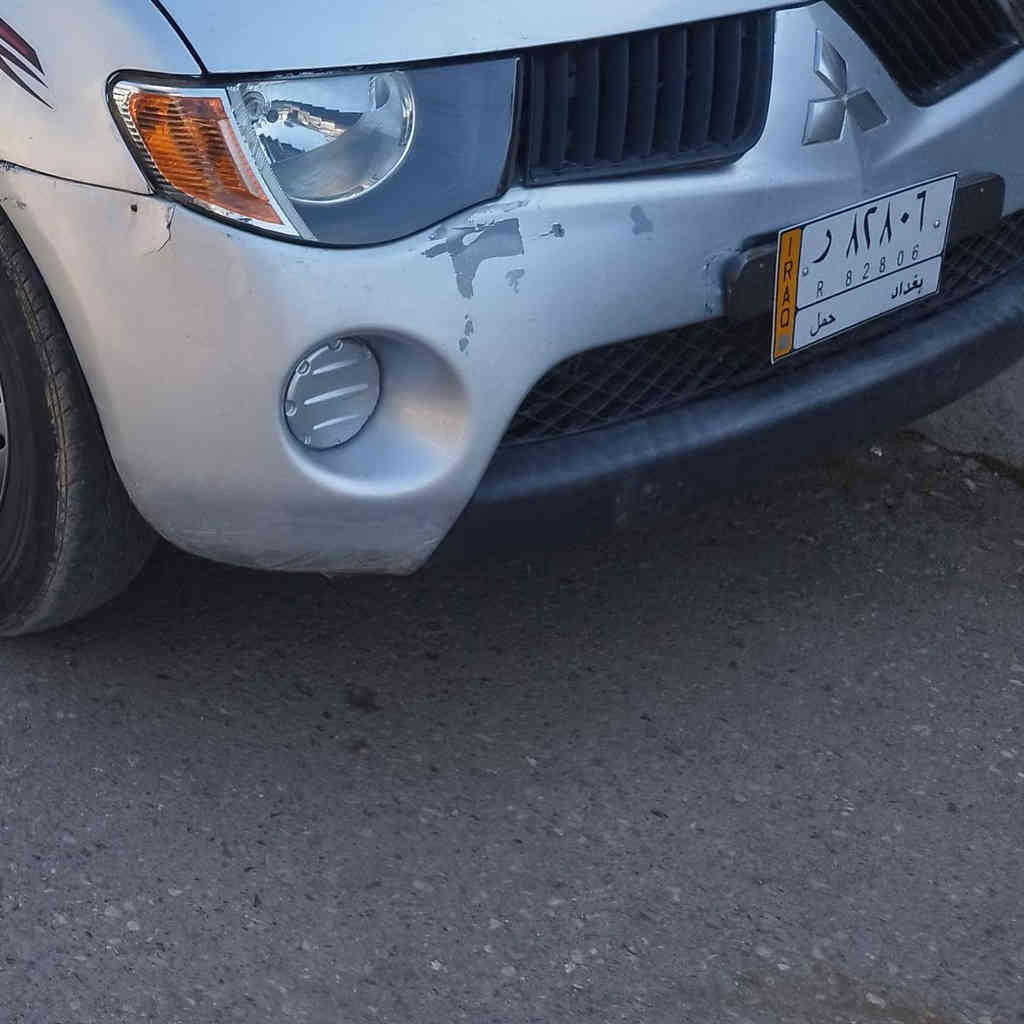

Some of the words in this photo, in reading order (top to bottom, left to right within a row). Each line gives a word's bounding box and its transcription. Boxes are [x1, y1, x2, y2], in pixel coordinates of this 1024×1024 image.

[846, 190, 927, 259] ٨٢٨٠٦
[816, 280, 825, 297] R
[845, 244, 919, 287] 82806
[891, 274, 924, 299] بغداد
[810, 312, 836, 337] حمل
